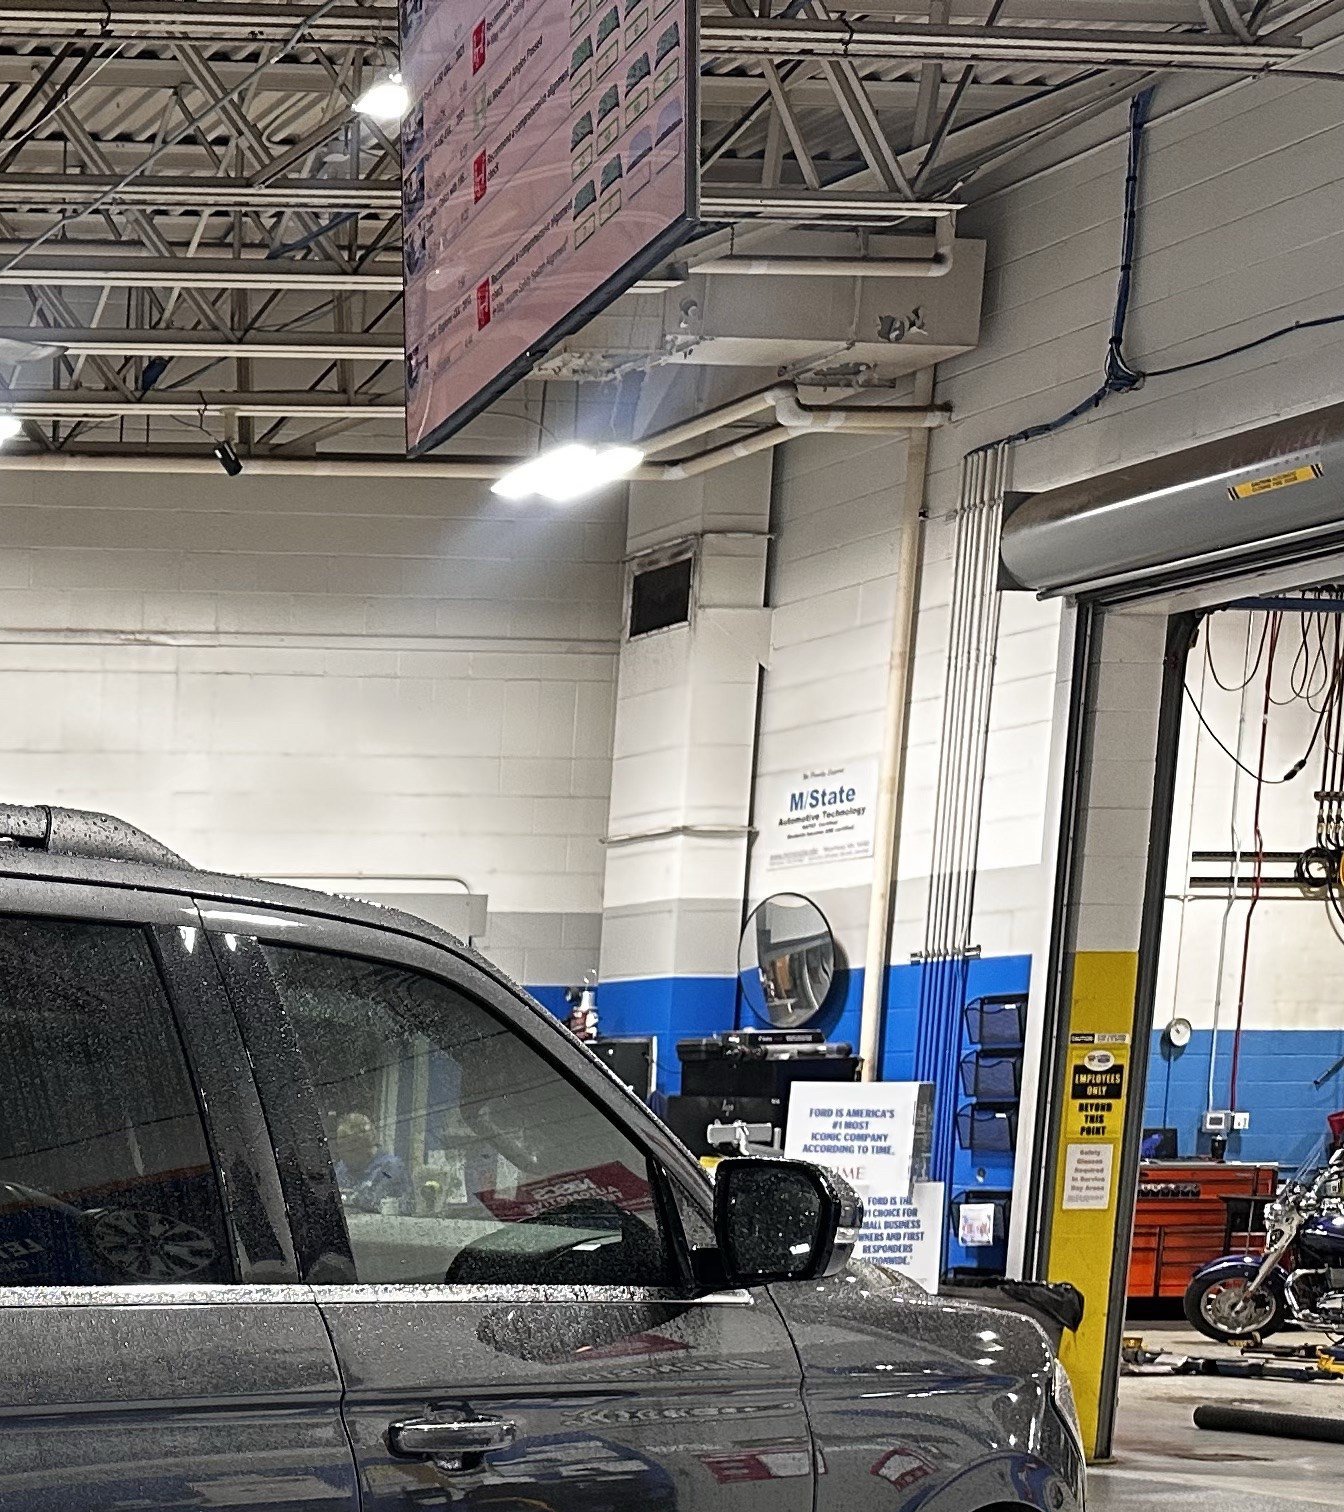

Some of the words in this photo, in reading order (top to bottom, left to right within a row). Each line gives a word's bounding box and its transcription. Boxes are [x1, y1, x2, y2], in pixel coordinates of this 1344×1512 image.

[822, 806, 866, 819] Technology
[1075, 1073, 1121, 1084] EMPLOYEES
[1086, 1085, 1107, 1096] ONLY
[1078, 1102, 1112, 1113] BEYOND
[809, 1108, 834, 1118] FORD
[835, 1108, 844, 1118] IS
[845, 1108, 895, 1119] AMERICA'S
[1084, 1114, 1104, 1124] THIS
[844, 1121, 869, 1130] MOST
[1080, 1125, 1107, 1136] POINT
[811, 1132, 841, 1142] ICONIC
[844, 1132, 888, 1142] COMPANY
[802, 1144, 855, 1154] ACCORDING
[857, 1145, 868, 1154] TO
[868, 1196, 888, 1205] FORD
[890, 1196, 897, 1205] IS
[873, 1208, 900, 1217] CHOICE
[903, 1208, 918, 1217] FOR
[862, 1219, 881, 1229] MALL
[884, 1219, 921, 1229] BUSINESS
[858, 1232, 884, 1242] WNERS
[886, 1232, 901, 1241] AND
[903, 1231, 924, 1241] FIRST
[862, 1244, 913, 1254] RESPONDERS
